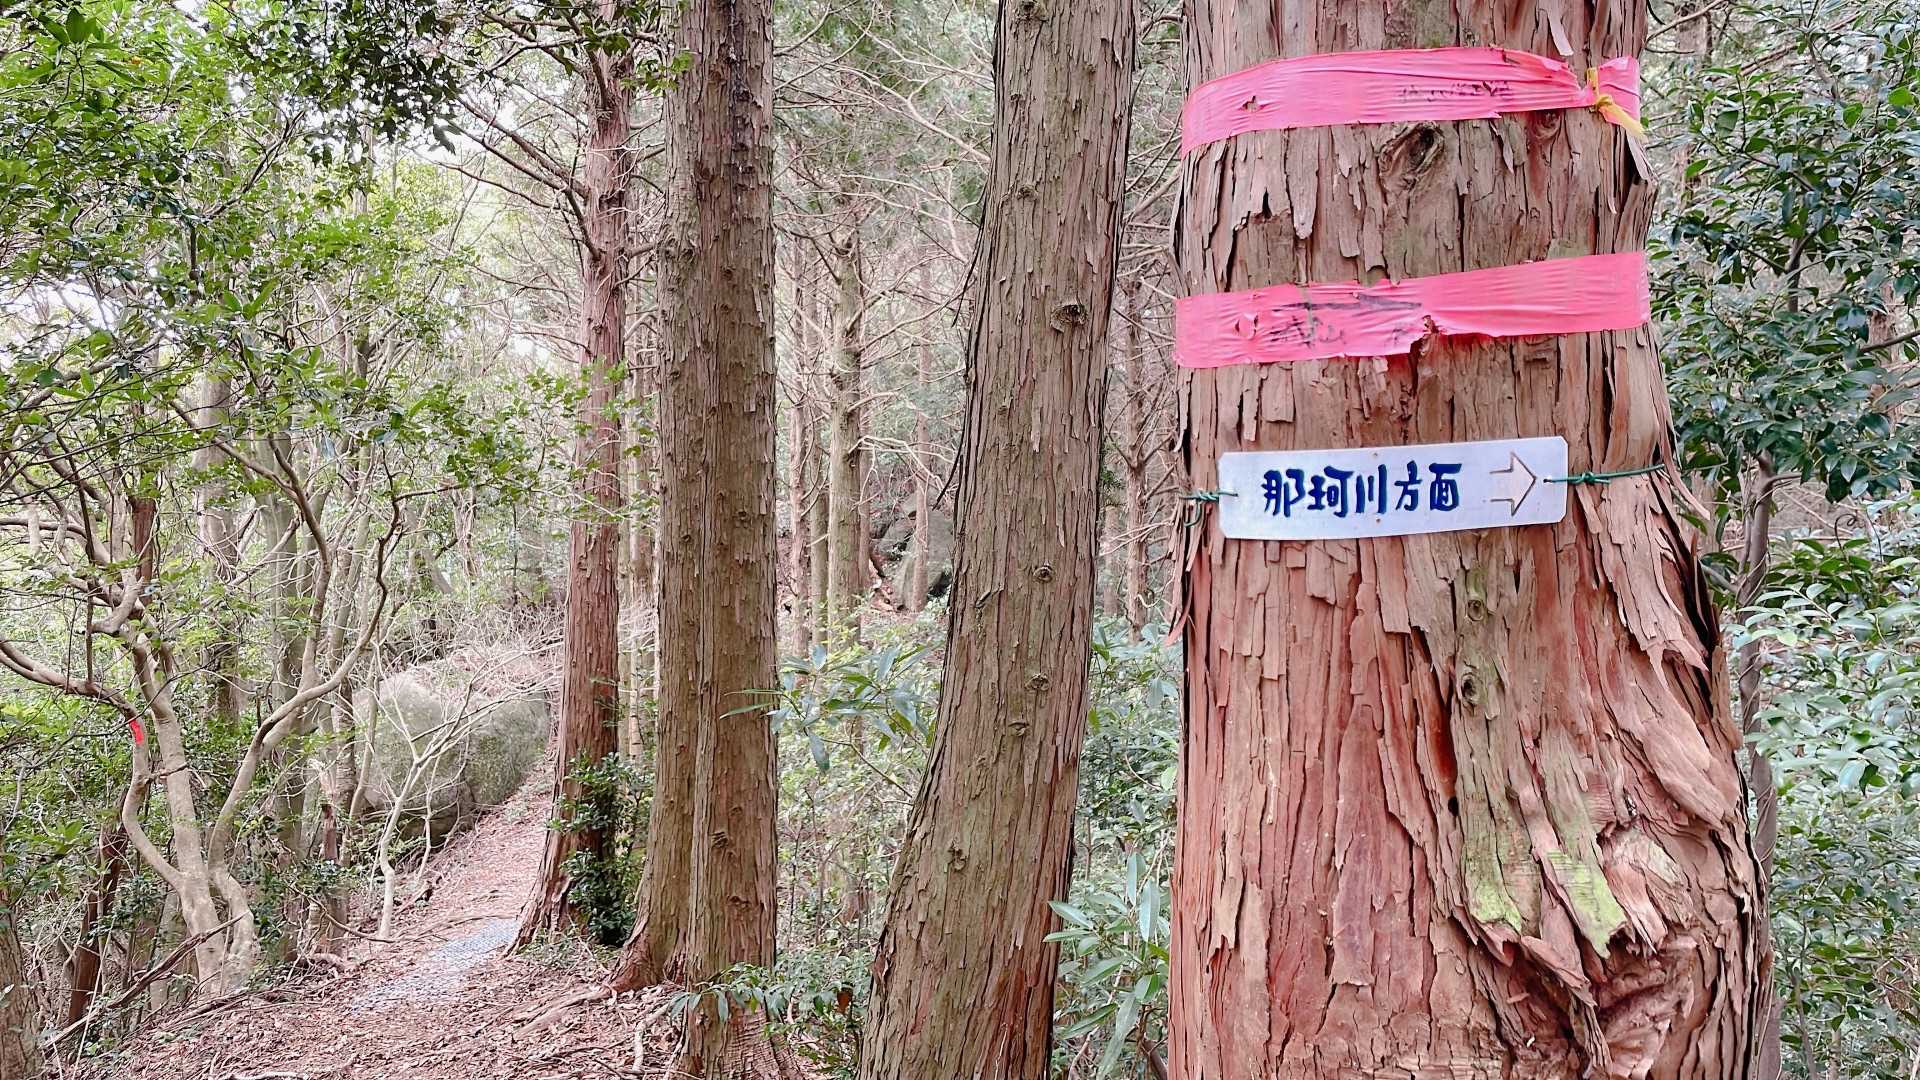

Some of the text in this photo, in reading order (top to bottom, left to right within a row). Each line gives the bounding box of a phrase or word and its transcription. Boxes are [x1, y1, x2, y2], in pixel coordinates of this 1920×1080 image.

[1261, 460, 1463, 518] 那珂川方面
